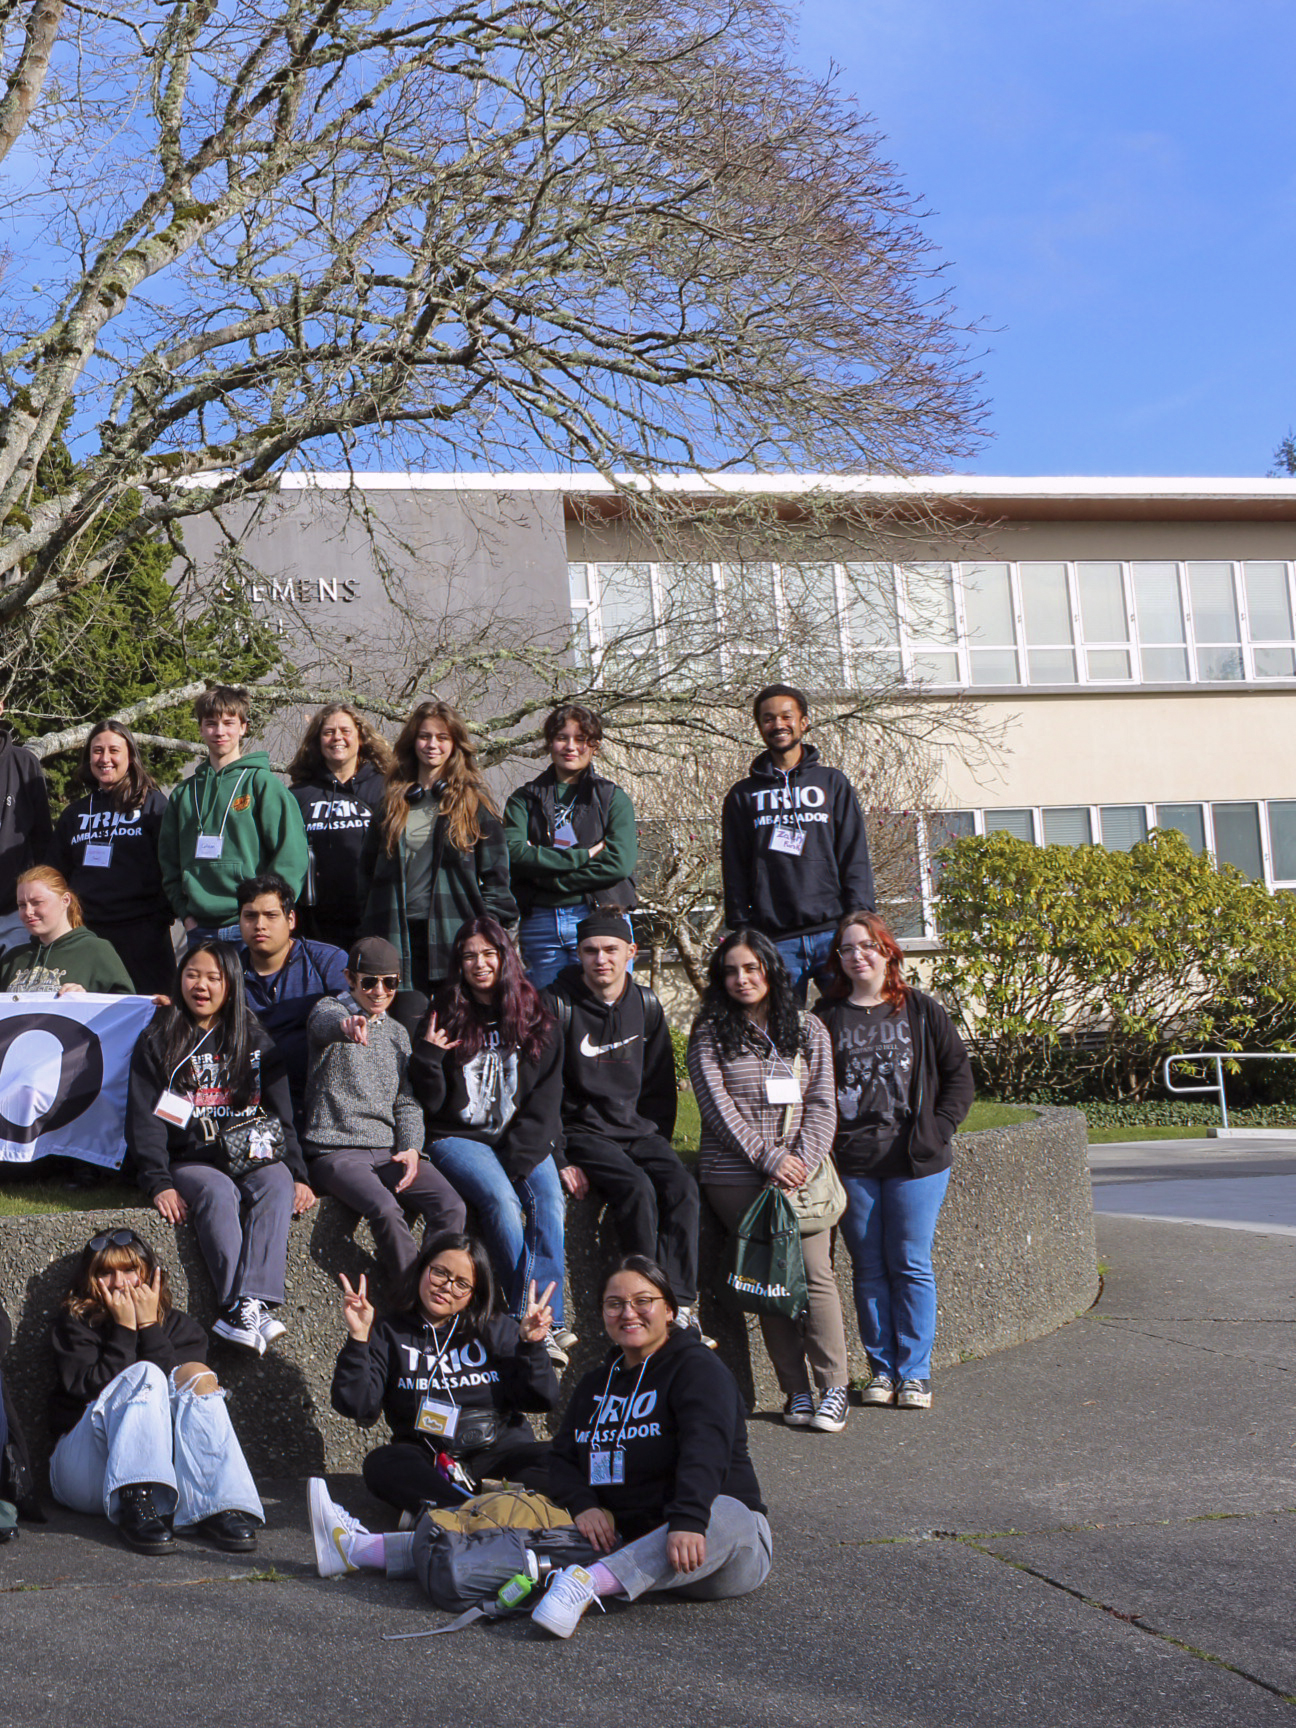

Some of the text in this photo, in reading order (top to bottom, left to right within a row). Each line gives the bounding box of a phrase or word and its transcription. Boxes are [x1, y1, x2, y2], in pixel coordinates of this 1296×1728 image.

[751, 786, 825, 811] TRIO
[78, 809, 141, 830] TRIO
[401, 1338, 487, 1374] TRIO
[398, 1370, 500, 1391] AMBASSADOR
[588, 1389, 658, 1424] TRIO
